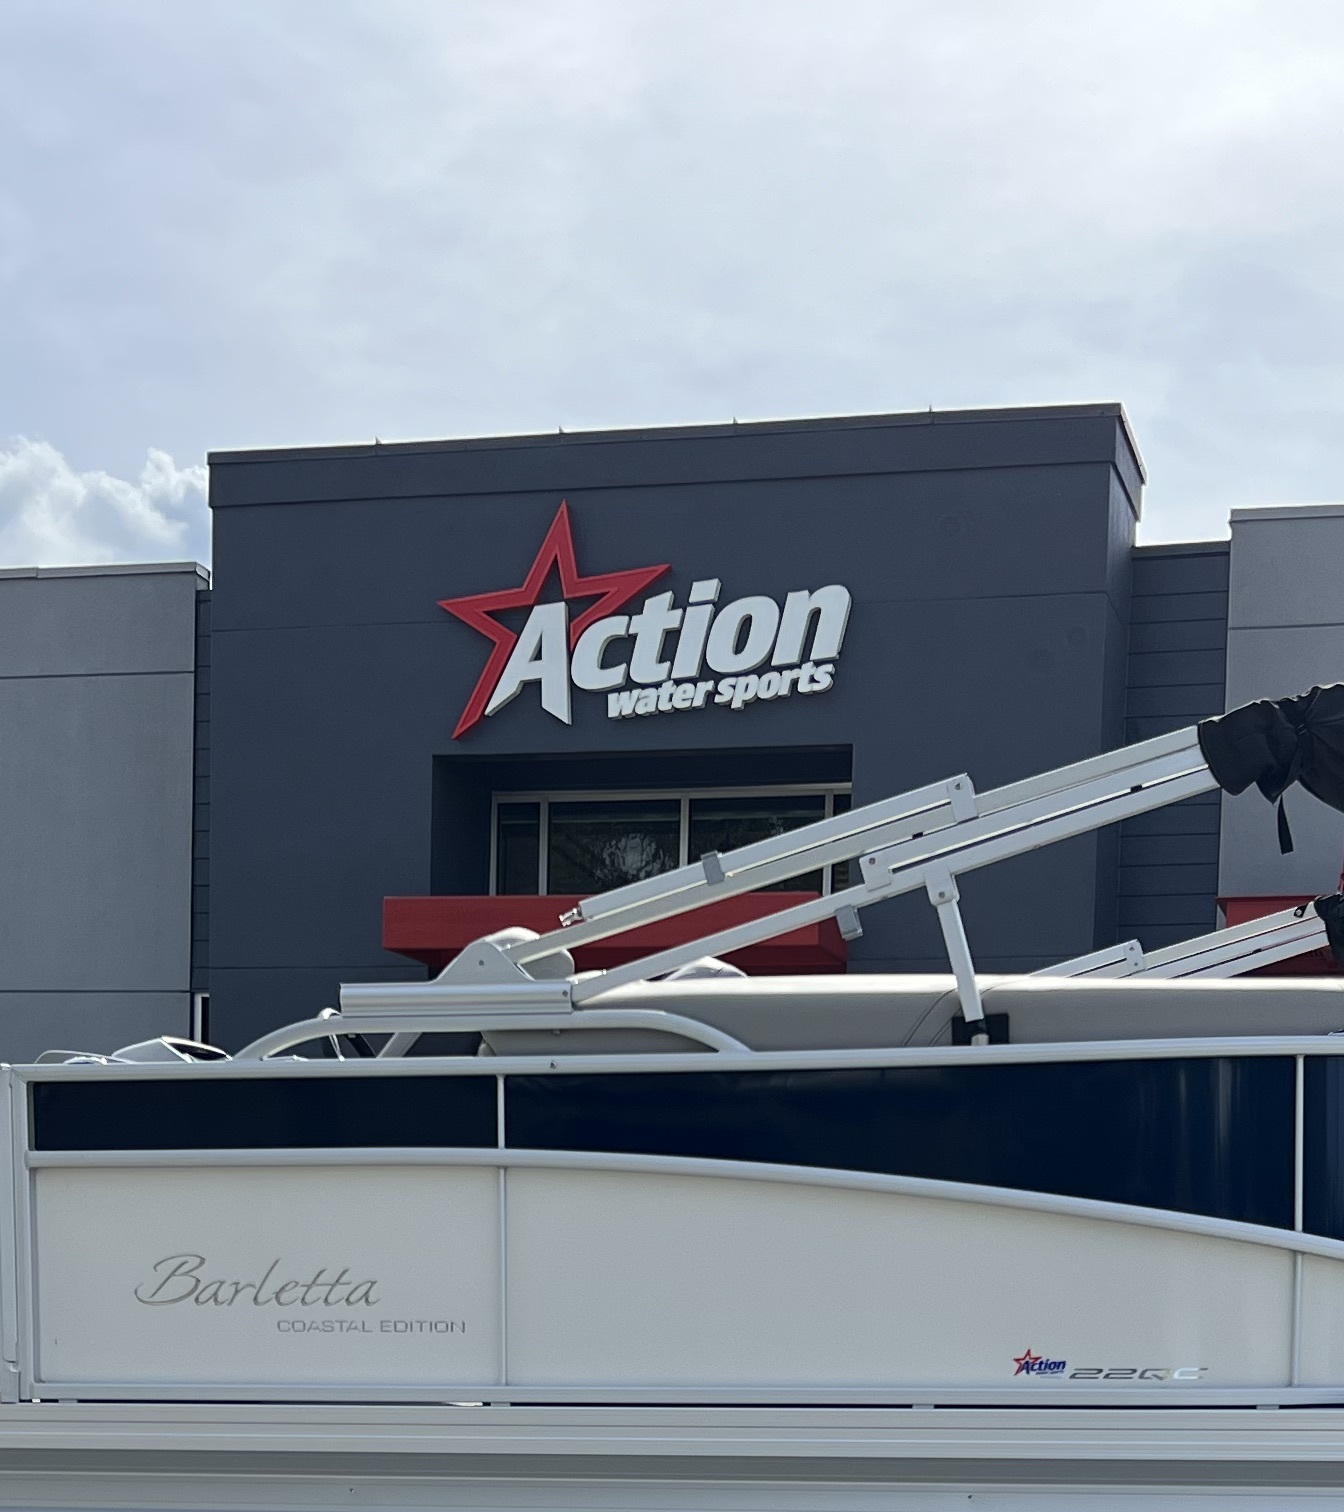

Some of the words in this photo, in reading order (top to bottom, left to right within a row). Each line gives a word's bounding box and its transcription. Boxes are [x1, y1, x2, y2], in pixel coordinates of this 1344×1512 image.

[485, 578, 852, 726] Action
[607, 680, 714, 719] water
[714, 661, 836, 709] sports
[134, 1253, 381, 1308] Barletta
[276, 1319, 375, 1335] COASTAL
[378, 1319, 468, 1335] EDITION
[1021, 1358, 1068, 1375] Action
